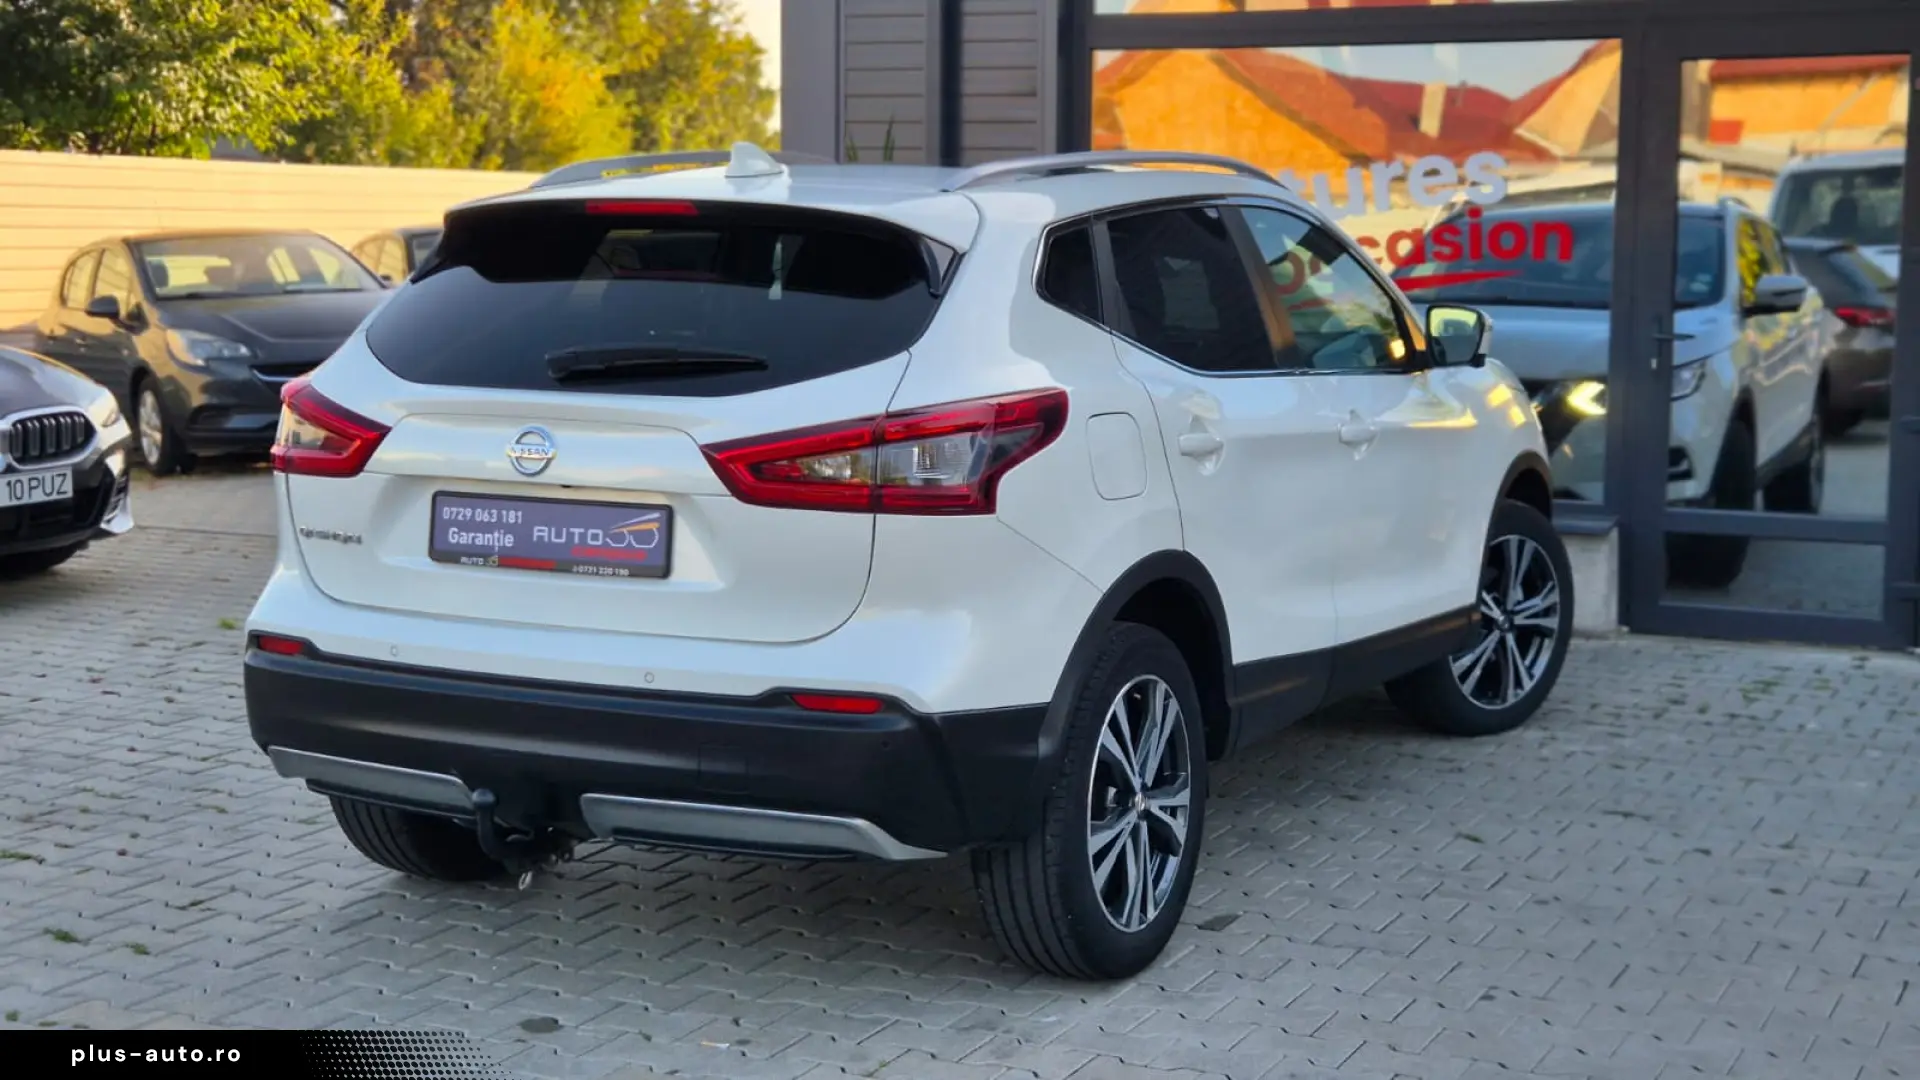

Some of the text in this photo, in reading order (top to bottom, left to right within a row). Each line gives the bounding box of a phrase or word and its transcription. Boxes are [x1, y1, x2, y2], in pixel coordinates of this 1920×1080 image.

[510, 445, 549, 457] NISSAN
[6, 473, 68, 502] 10 PUZ
[443, 507, 522, 524] 0729 063 181
[533, 526, 602, 545] AUTO
